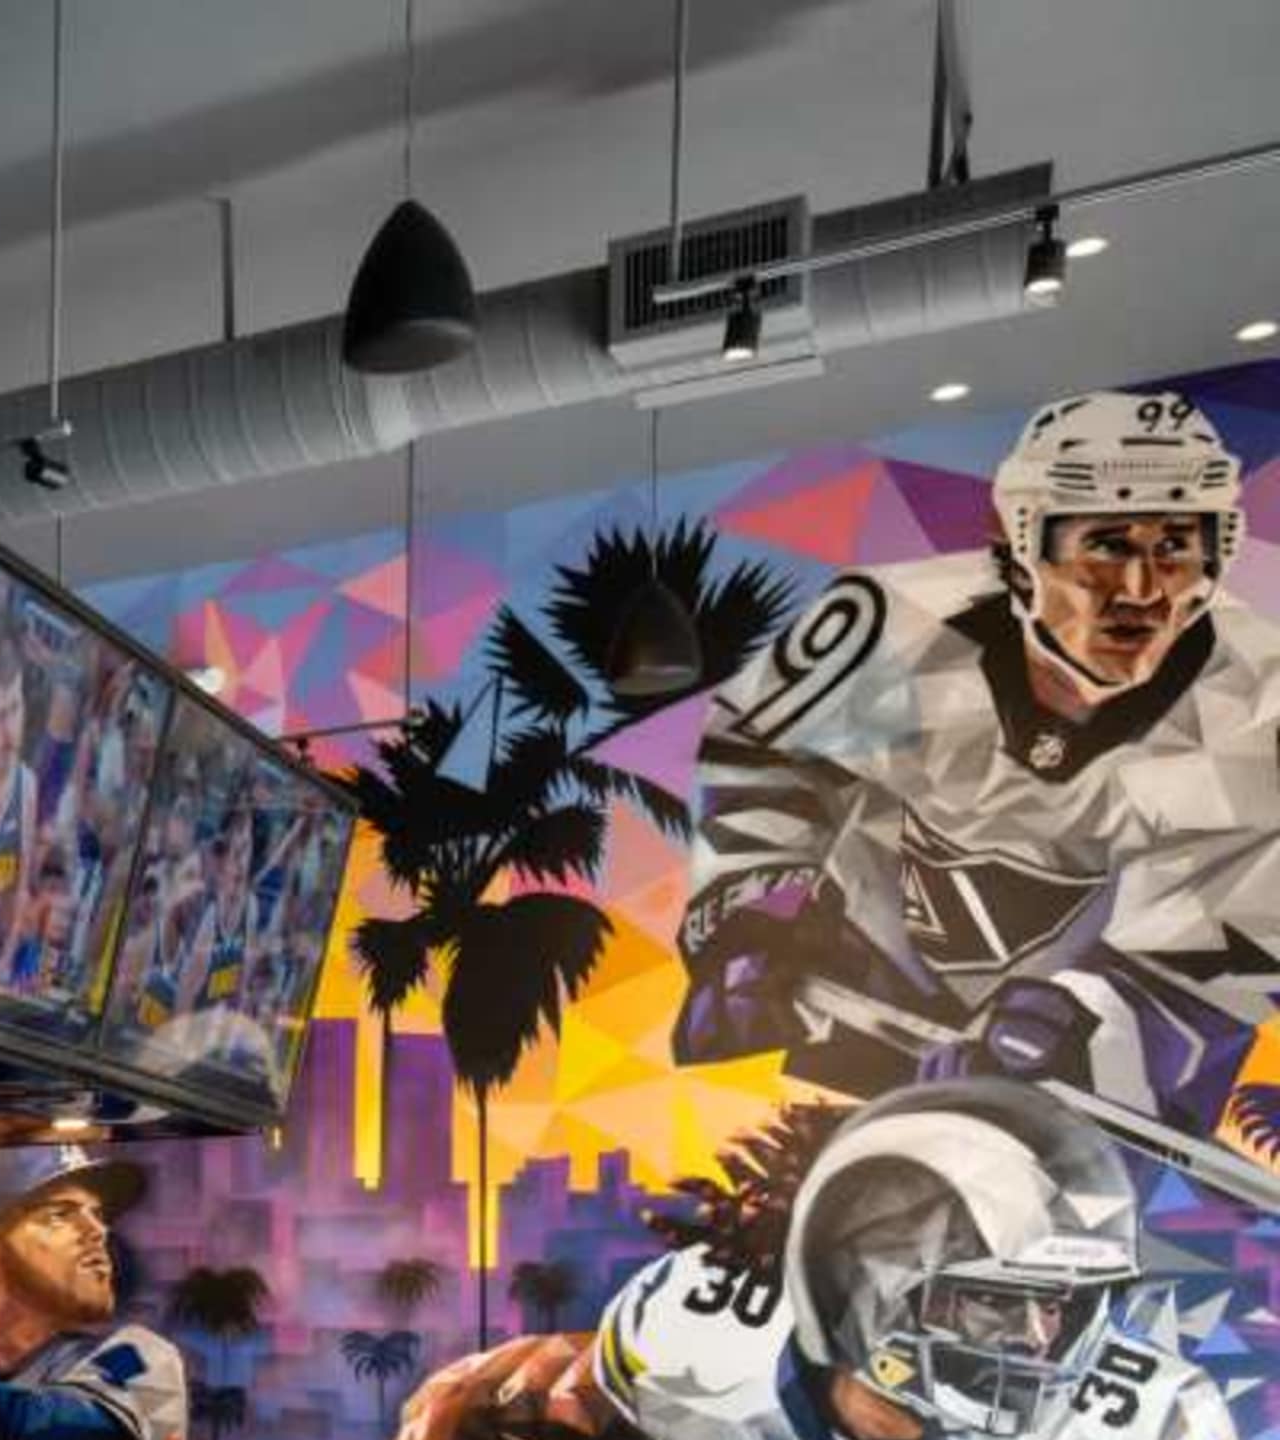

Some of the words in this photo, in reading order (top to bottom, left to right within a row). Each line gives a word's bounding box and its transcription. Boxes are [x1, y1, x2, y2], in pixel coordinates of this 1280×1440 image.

[1137, 400, 1193, 432] 99
[683, 1255, 784, 1329] 30
[1069, 1343, 1158, 1429] 30
